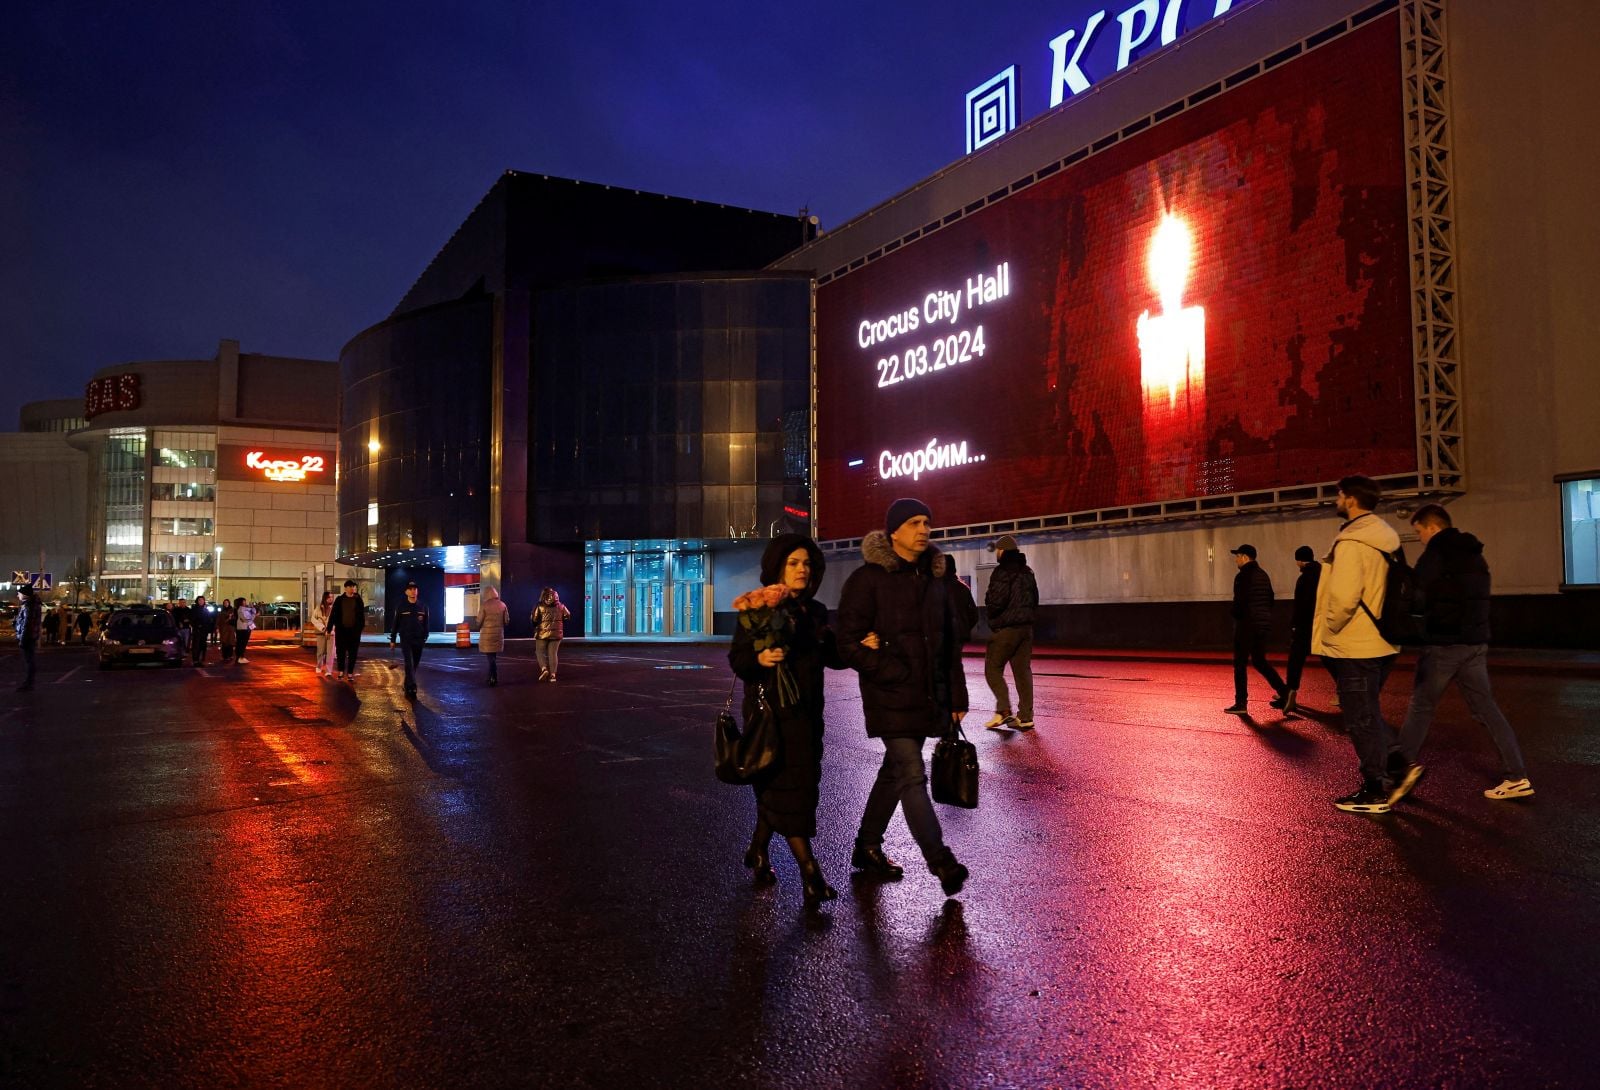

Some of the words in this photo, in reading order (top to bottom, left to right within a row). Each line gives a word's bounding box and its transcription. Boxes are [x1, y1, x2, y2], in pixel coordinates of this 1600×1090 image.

[858, 306, 920, 349] Crocus
[923, 290, 962, 324] City
[966, 261, 1010, 310] Hall
[877, 325, 986, 388] 22.03.2024
[301, 455, 324, 472] 22
[878, 438, 986, 481] Скорбим...
